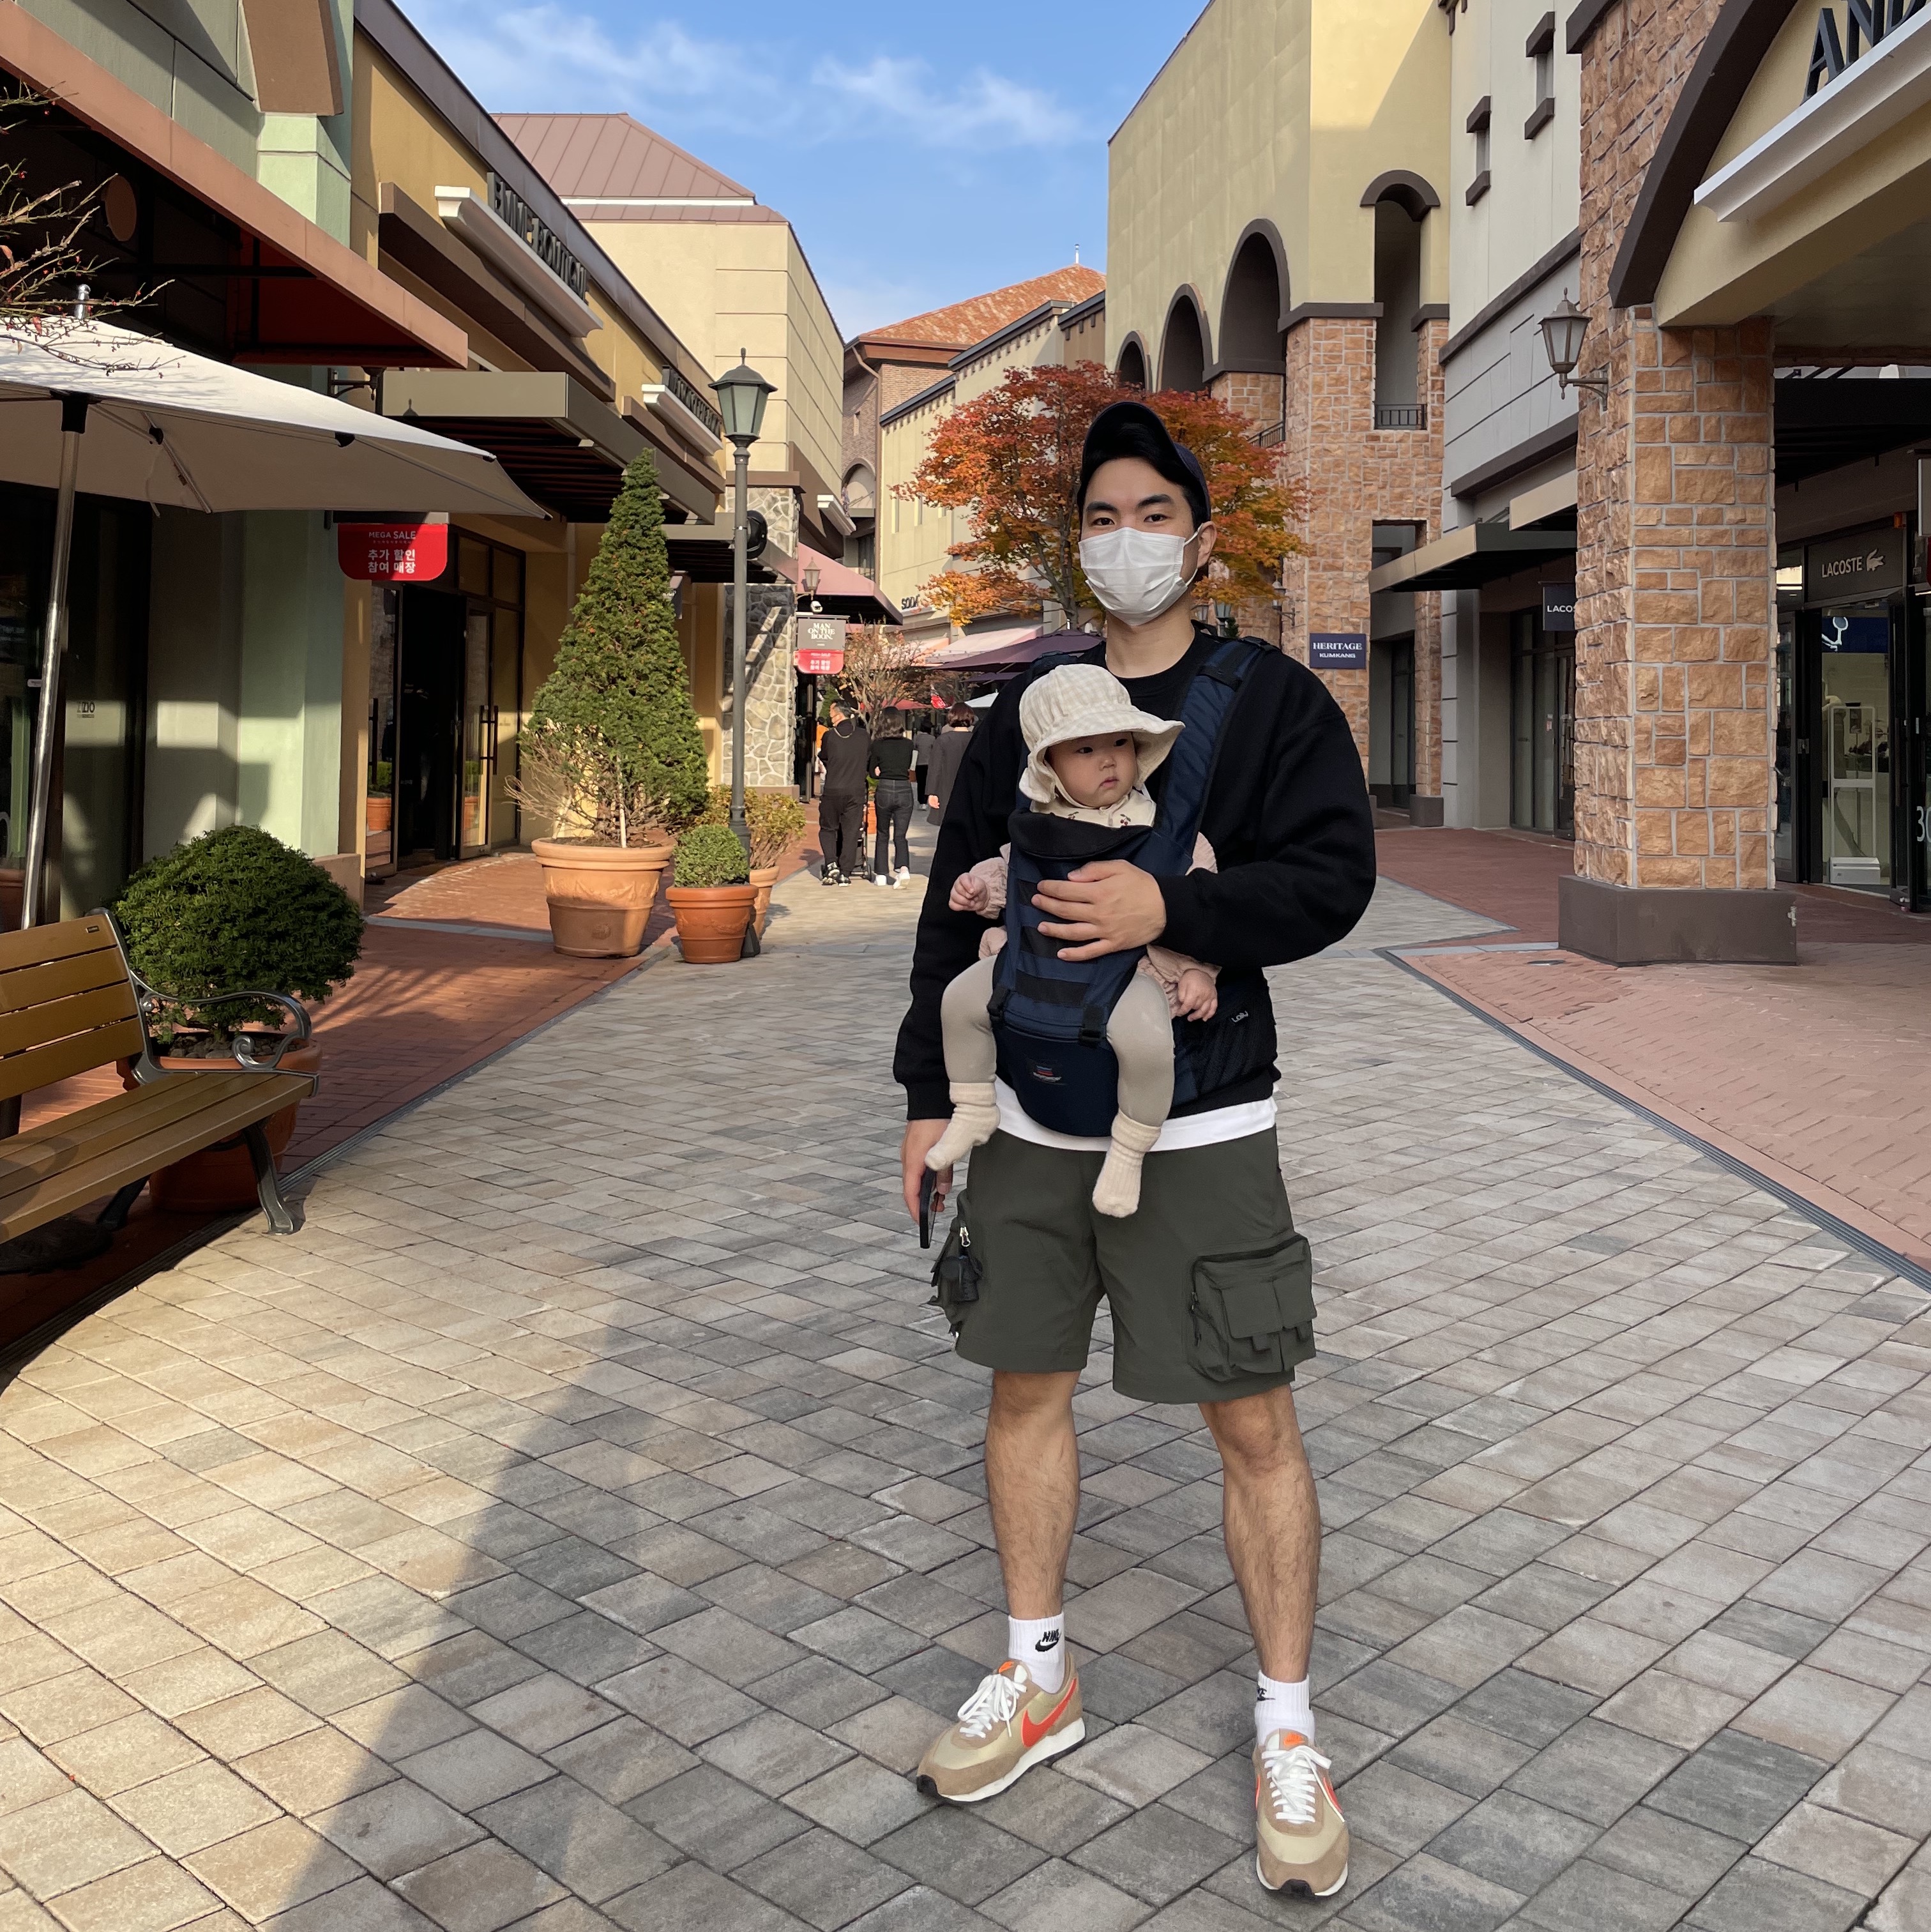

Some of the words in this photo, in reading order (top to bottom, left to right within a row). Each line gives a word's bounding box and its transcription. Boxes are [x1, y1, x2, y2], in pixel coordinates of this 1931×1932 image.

[393, 531, 416, 540] SALE
[368, 549, 390, 561] 추가
[393, 549, 416, 561] 할인
[368, 561, 390, 574] 참여
[393, 561, 416, 574] 매장
[1822, 556, 1863, 578] LACOSTE
[1547, 605, 1575, 613] LACO
[1313, 642, 1363, 650] HERITAGE
